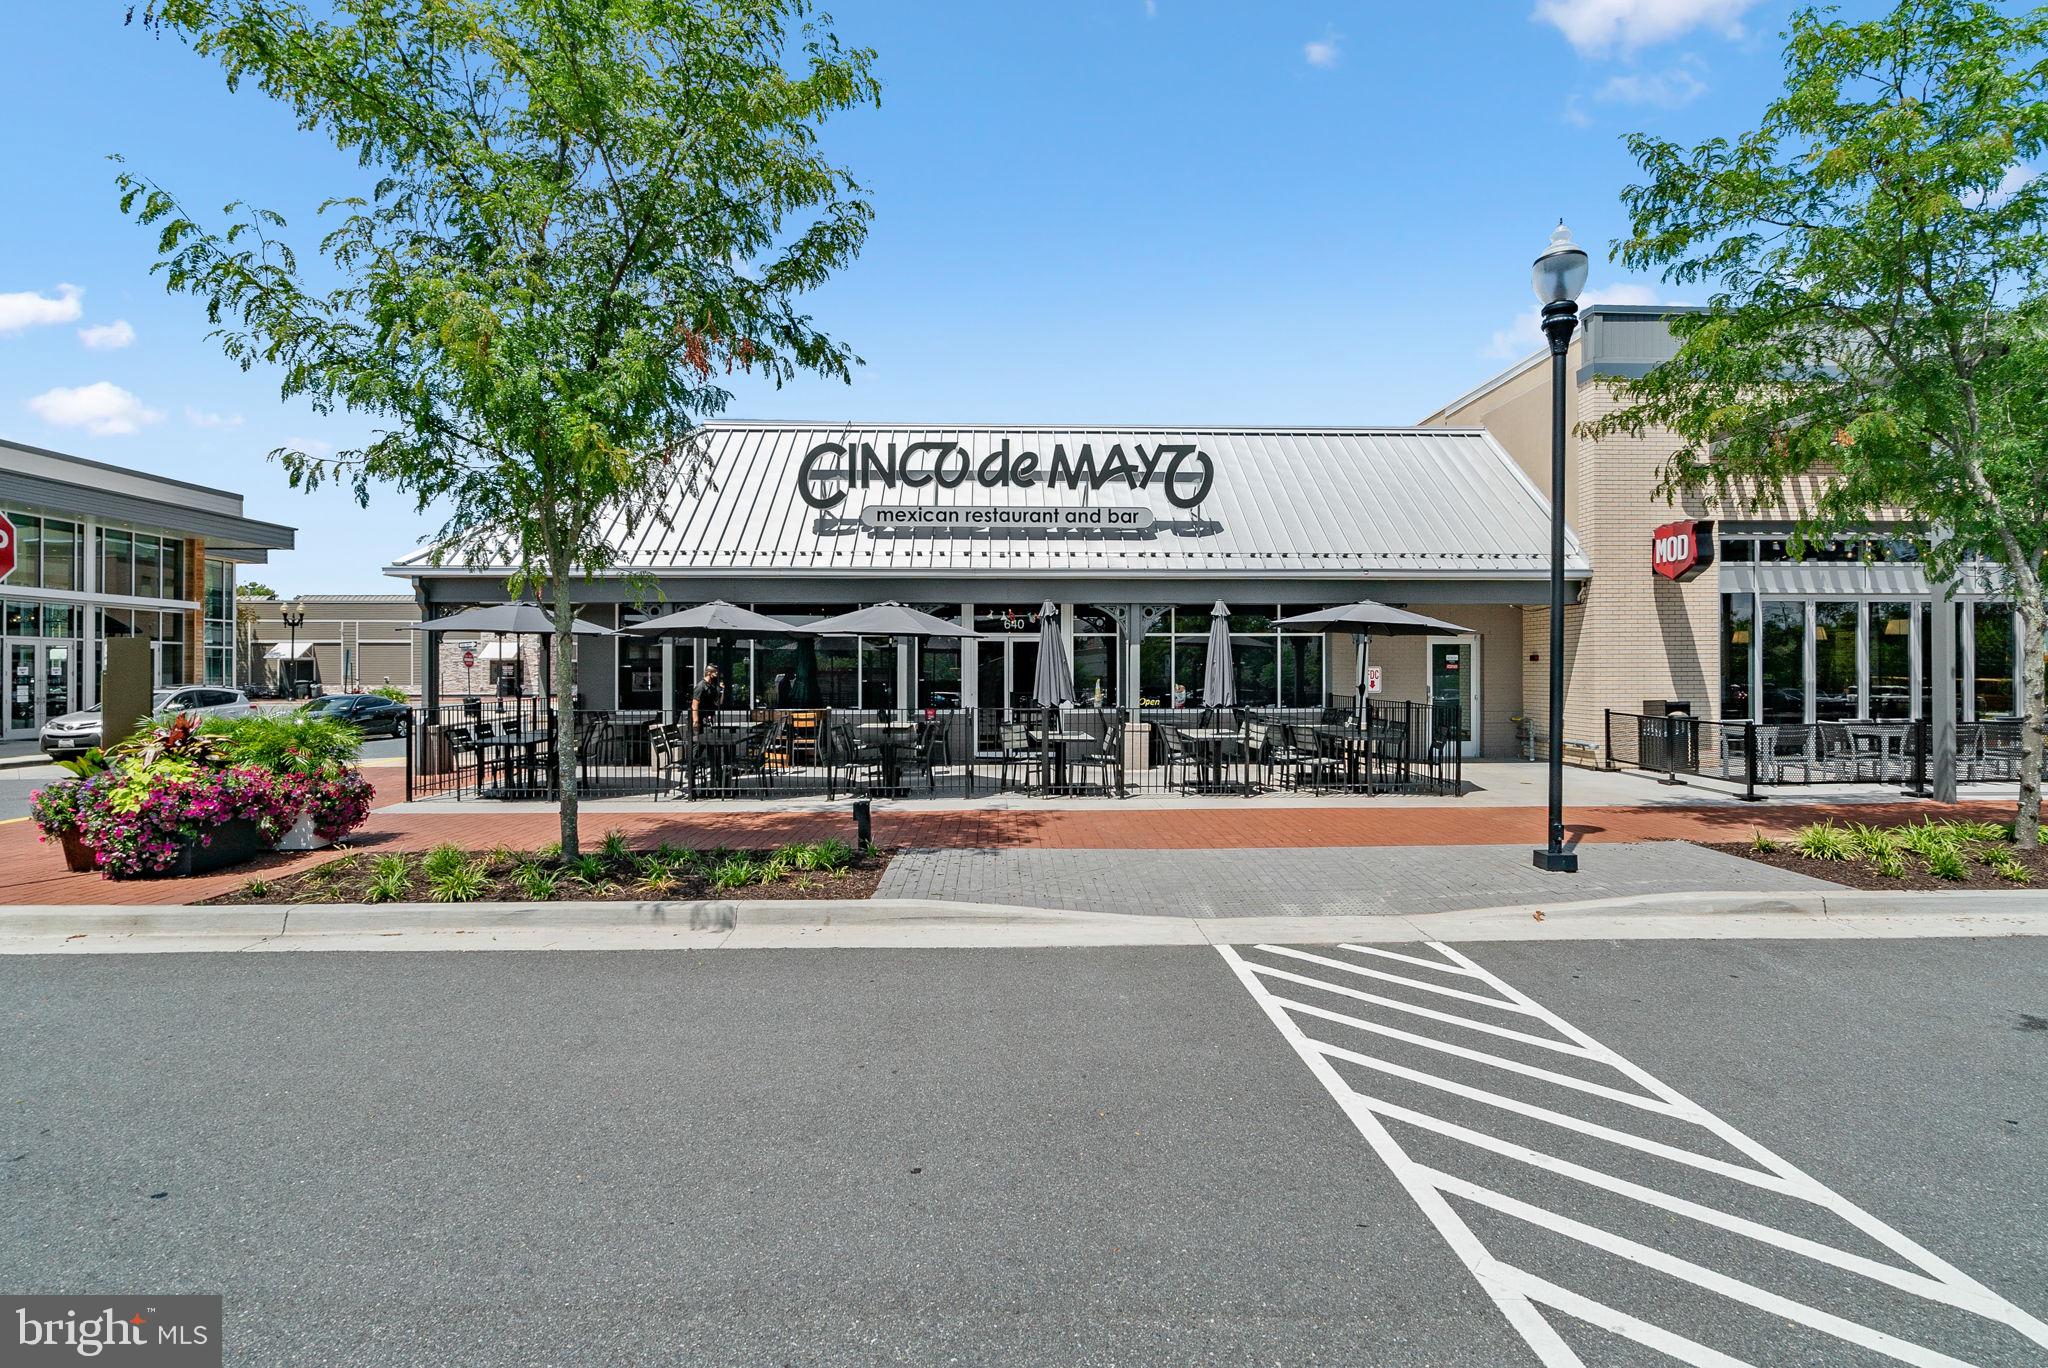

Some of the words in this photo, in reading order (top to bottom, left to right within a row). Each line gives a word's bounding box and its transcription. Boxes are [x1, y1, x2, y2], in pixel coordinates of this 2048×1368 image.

[798, 442, 970, 509] CINCO
[977, 438, 1039, 488] de
[1047, 443, 1214, 509] MAYO
[876, 508, 959, 524] mexican
[965, 508, 1060, 524] restaurant
[1065, 508, 1101, 524] and
[1108, 508, 1139, 524] bar
[1655, 533, 1689, 564] MOD
[1003, 619, 1025, 630] 640
[1139, 697, 1161, 707] Open
